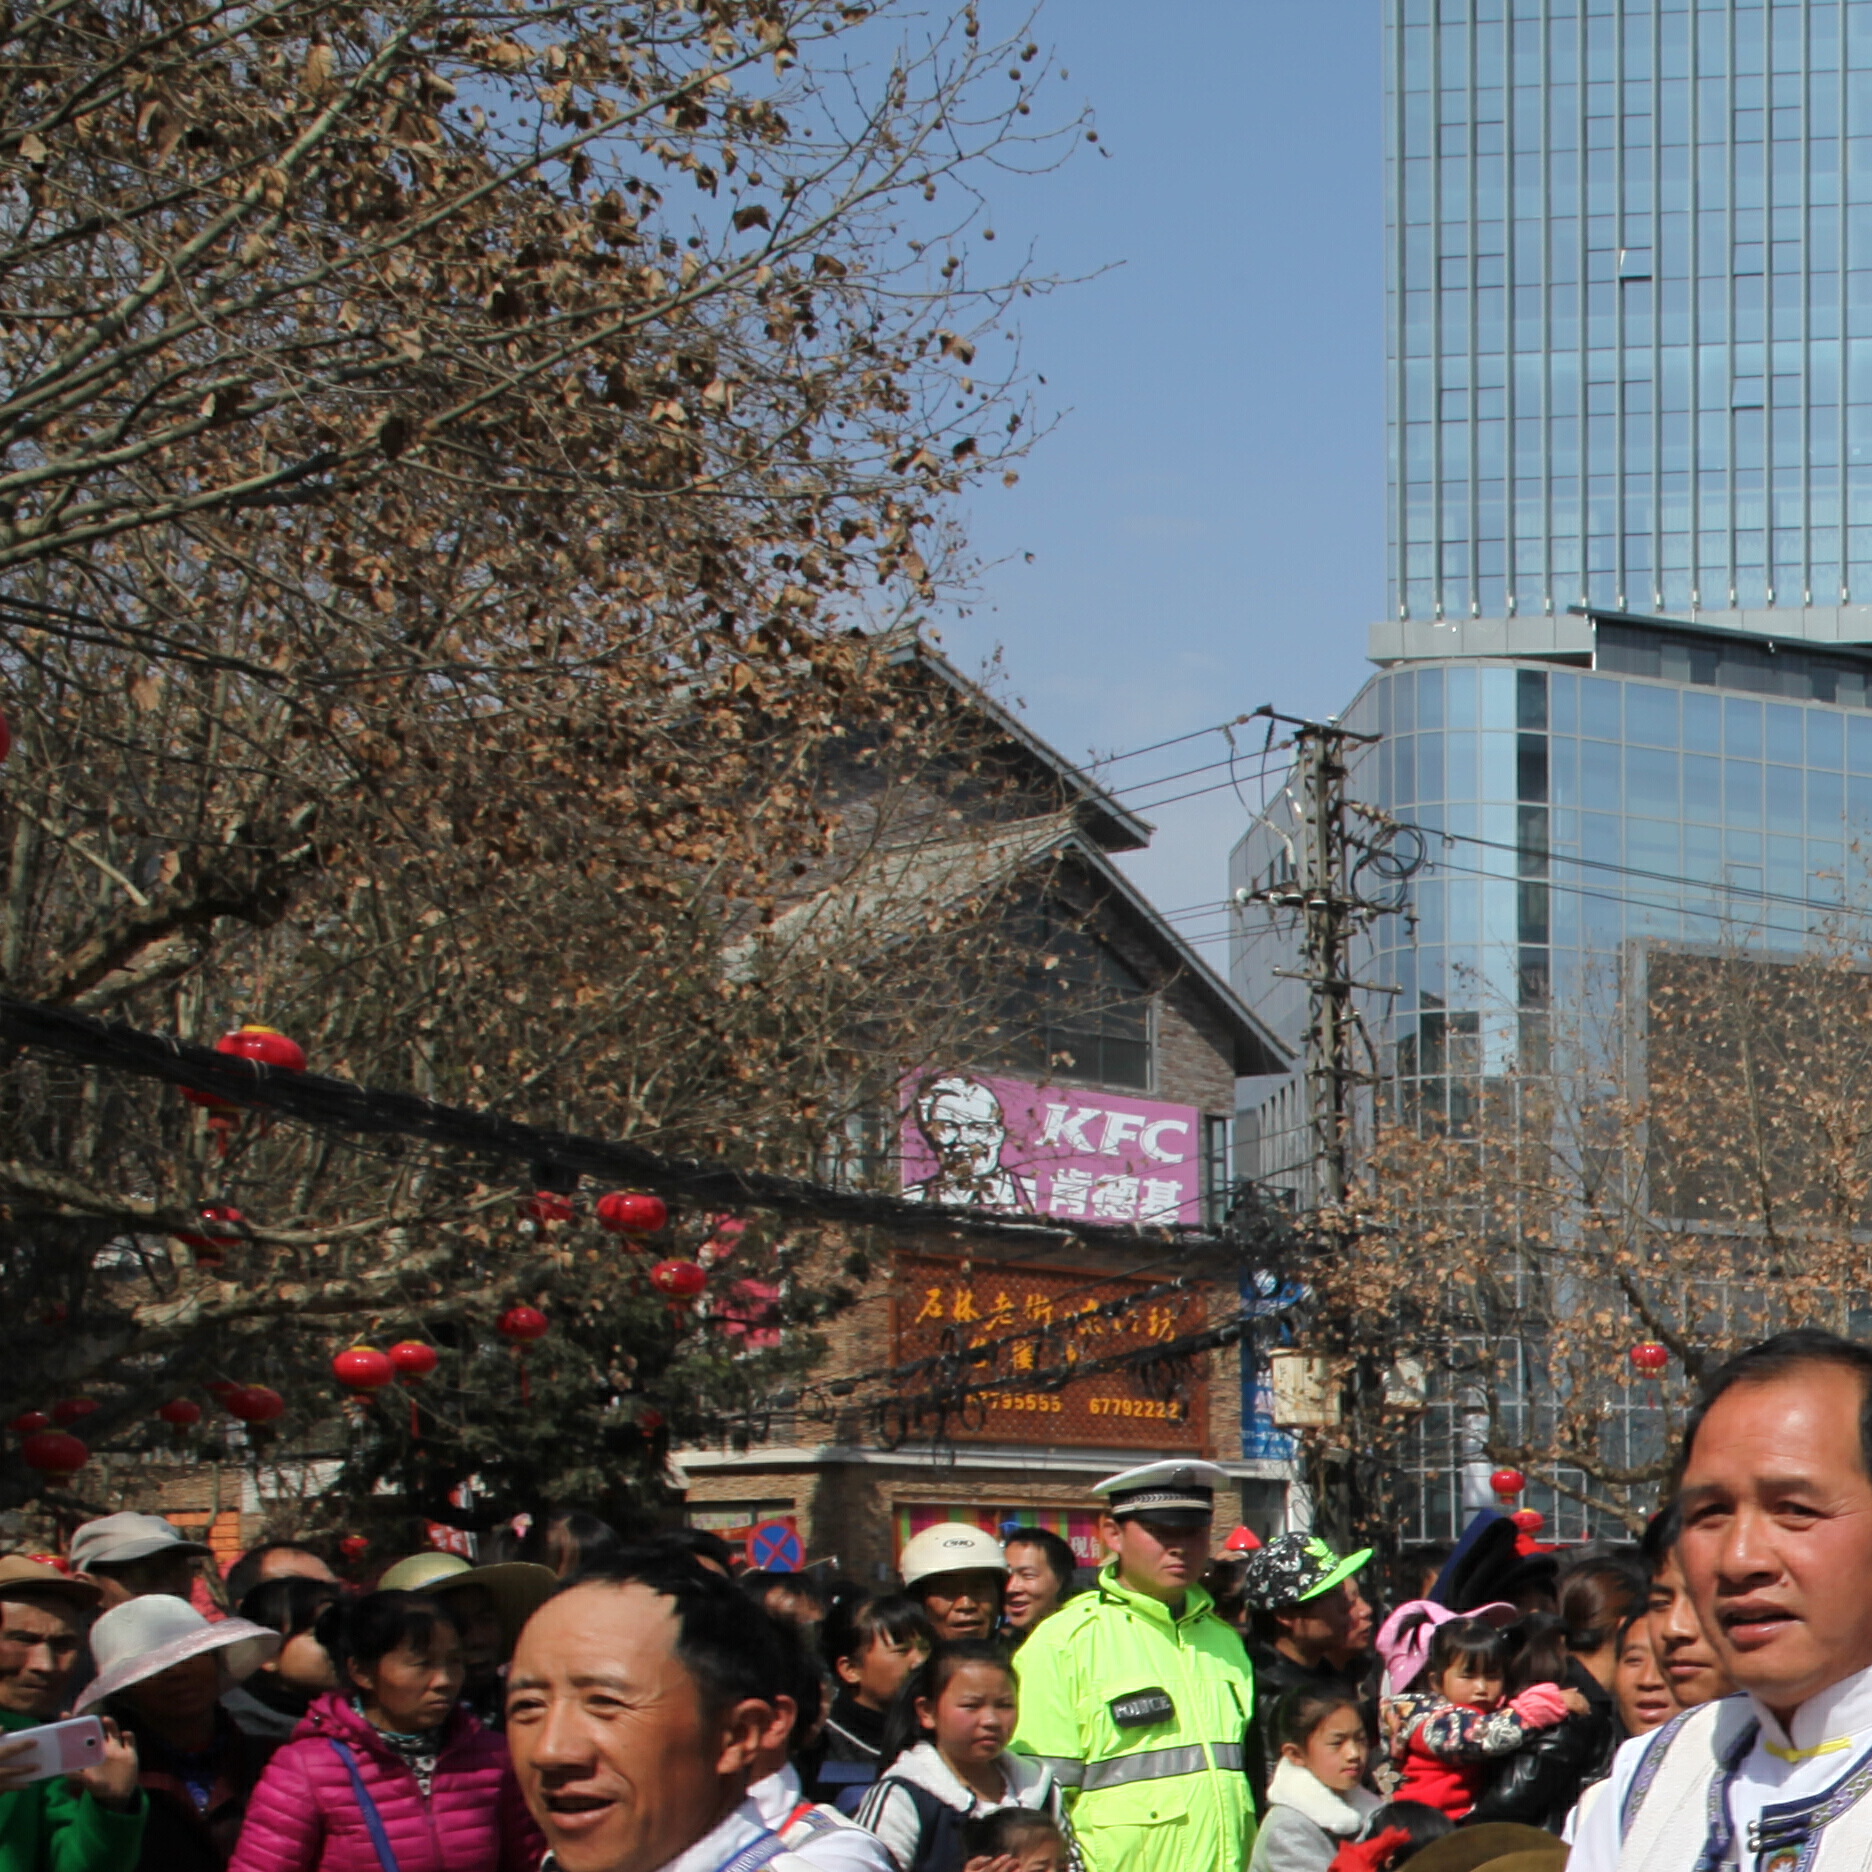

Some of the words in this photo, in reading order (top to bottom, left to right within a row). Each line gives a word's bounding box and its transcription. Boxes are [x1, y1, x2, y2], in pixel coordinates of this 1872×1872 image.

[1034, 1103, 1189, 1164] KFC
[1050, 1168, 1183, 1225] 肯德基
[1089, 1397, 1181, 1420] 67792222
